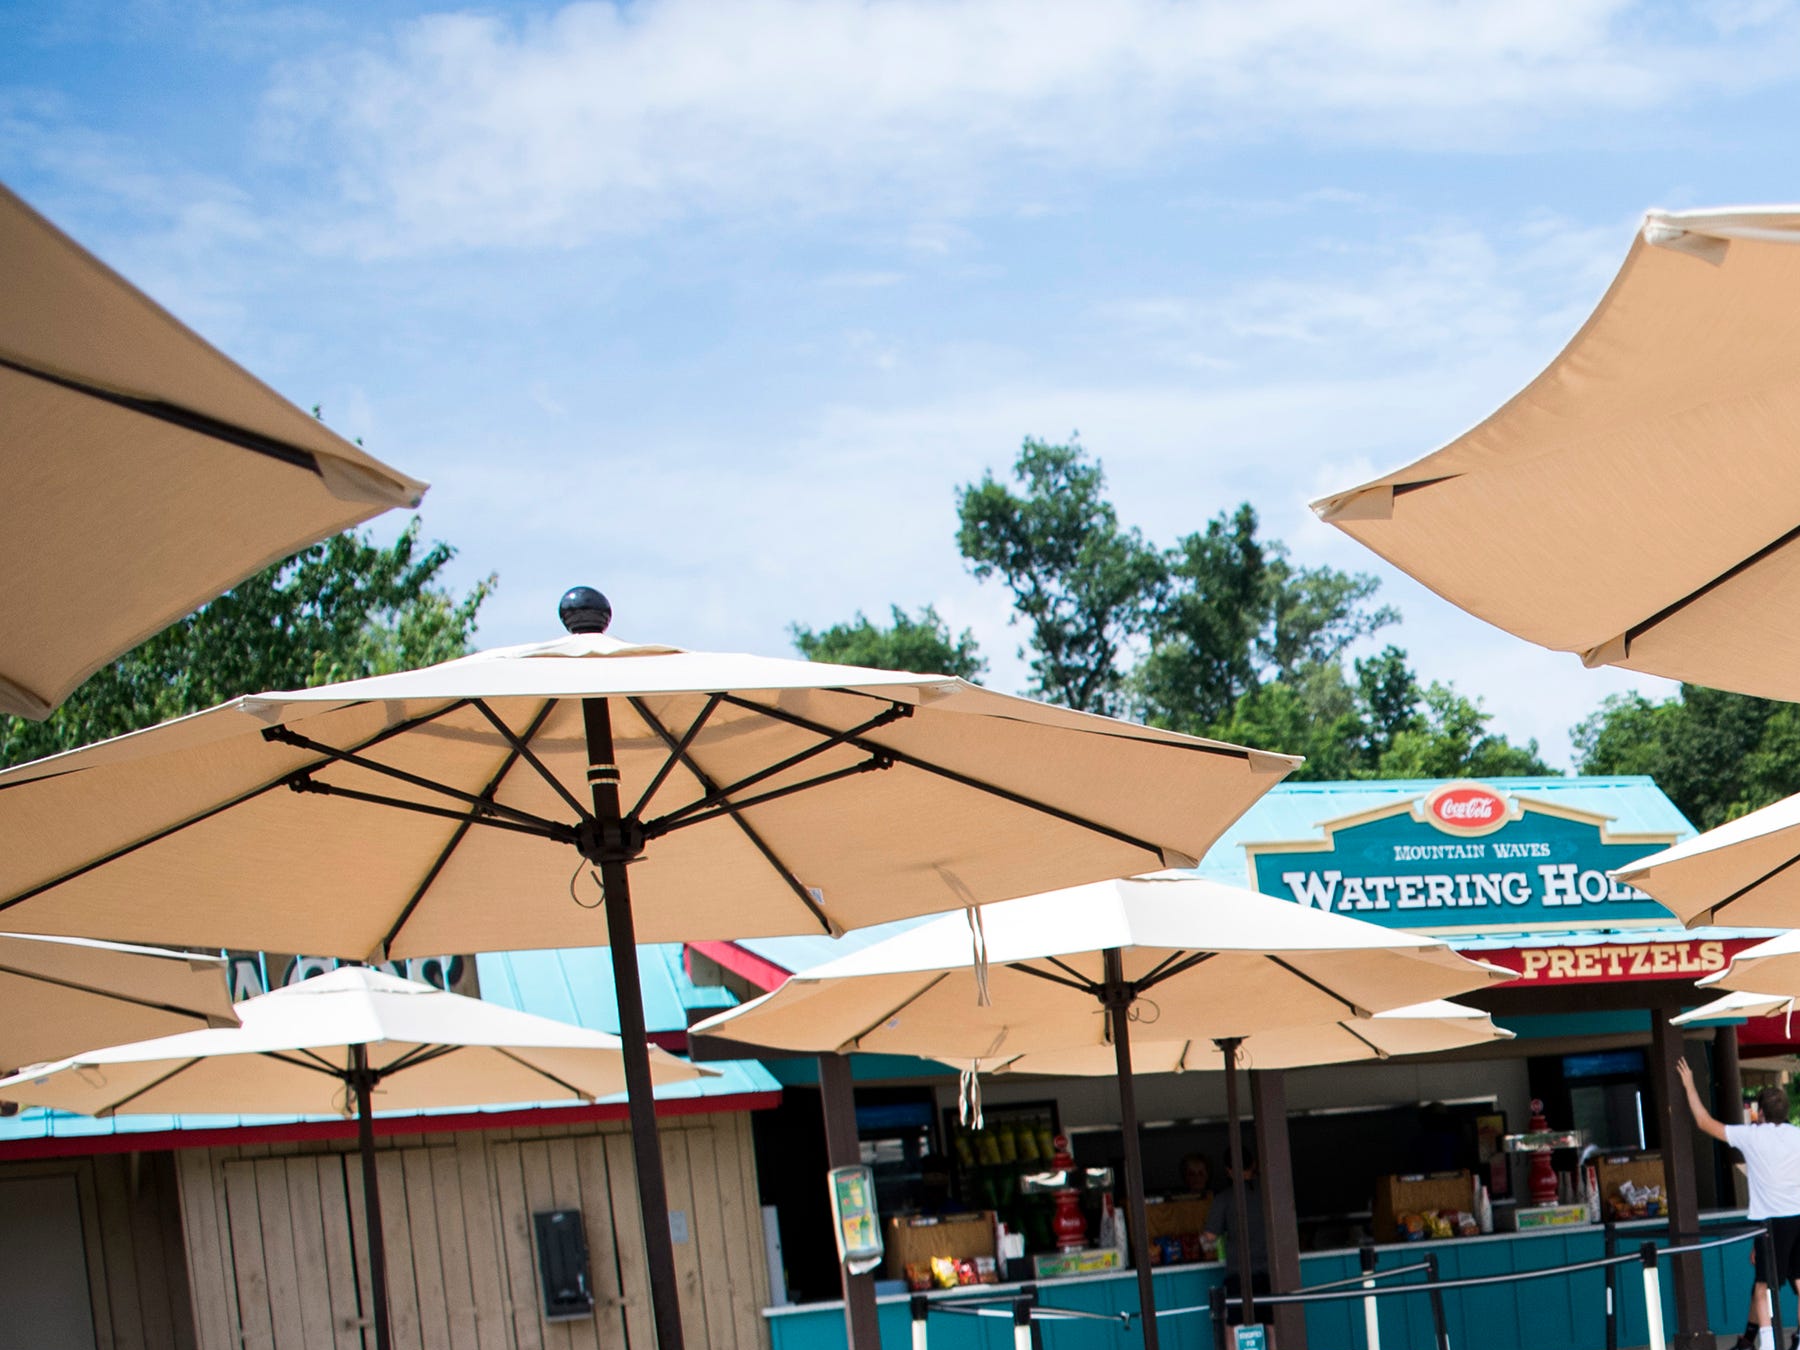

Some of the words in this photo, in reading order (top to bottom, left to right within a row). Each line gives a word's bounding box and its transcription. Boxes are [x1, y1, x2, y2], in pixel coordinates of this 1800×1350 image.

[1440, 797, 1496, 820] Coca-Cola
[1393, 843, 1486, 861] MOUNTAIN
[1492, 842, 1551, 859] WAVES
[1282, 870, 1533, 912] WATERING
[1521, 941, 1726, 979] PRETZELS
